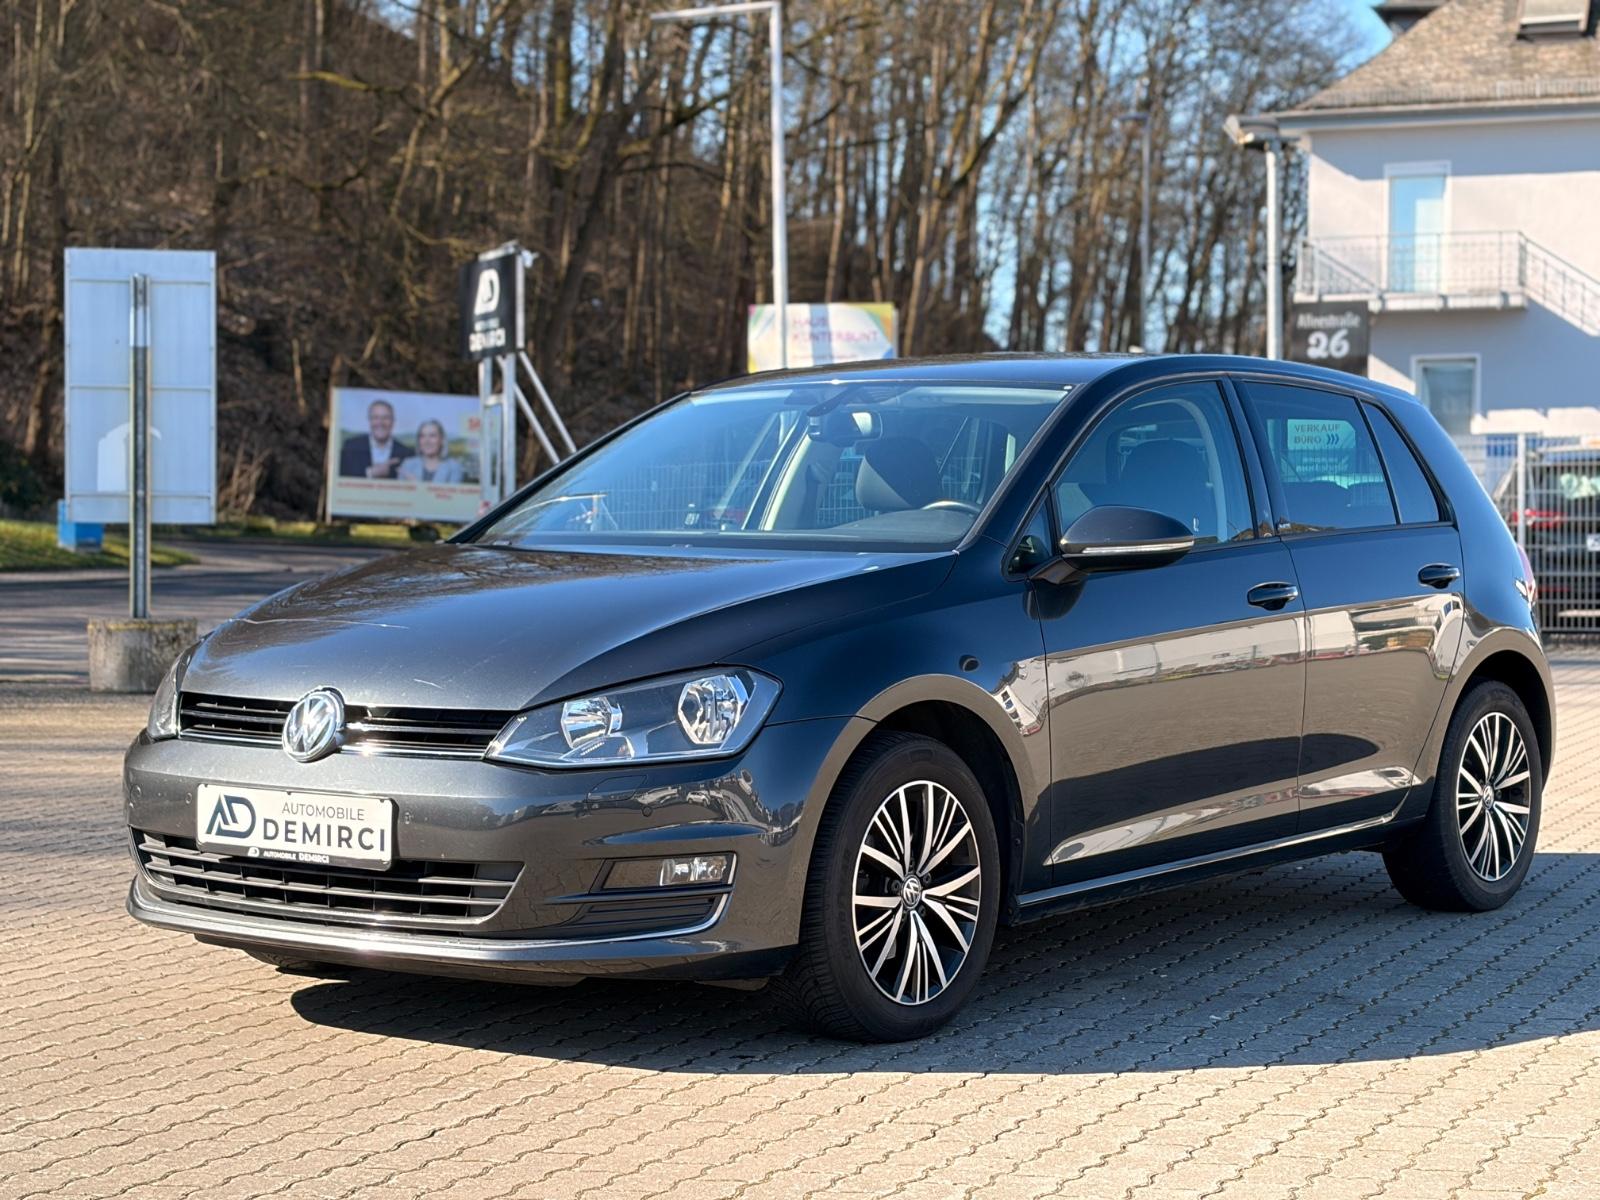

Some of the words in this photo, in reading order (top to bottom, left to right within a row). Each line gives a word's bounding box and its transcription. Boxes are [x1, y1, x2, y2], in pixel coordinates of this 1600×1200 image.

[1307, 328, 1350, 359] 26
[1294, 423, 1341, 433] VERKAUF
[1293, 434, 1322, 445] BÜRO
[281, 801, 366, 821] AUTOMOBILE
[263, 817, 386, 852] DEMIRCI
[263, 849, 297, 860] AUTOMOBILE
[298, 852, 330, 864] DEMIRCI
